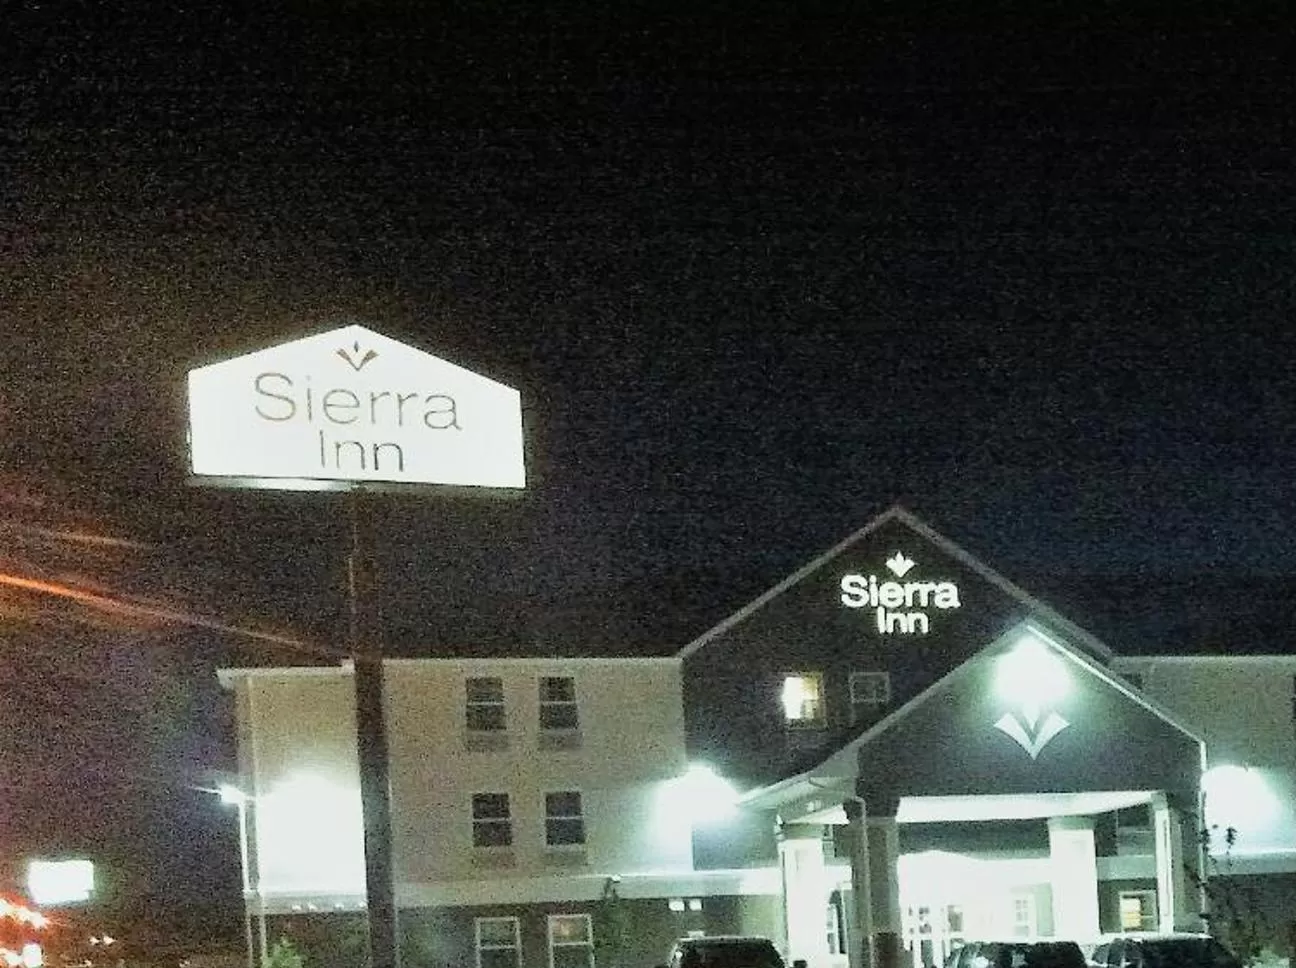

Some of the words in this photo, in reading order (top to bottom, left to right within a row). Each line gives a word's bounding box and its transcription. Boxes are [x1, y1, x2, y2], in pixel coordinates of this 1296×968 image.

[254, 372, 463, 431] Sierra
[319, 429, 404, 472] Inn
[841, 574, 961, 608] Sierra
[877, 606, 929, 634] Inn
